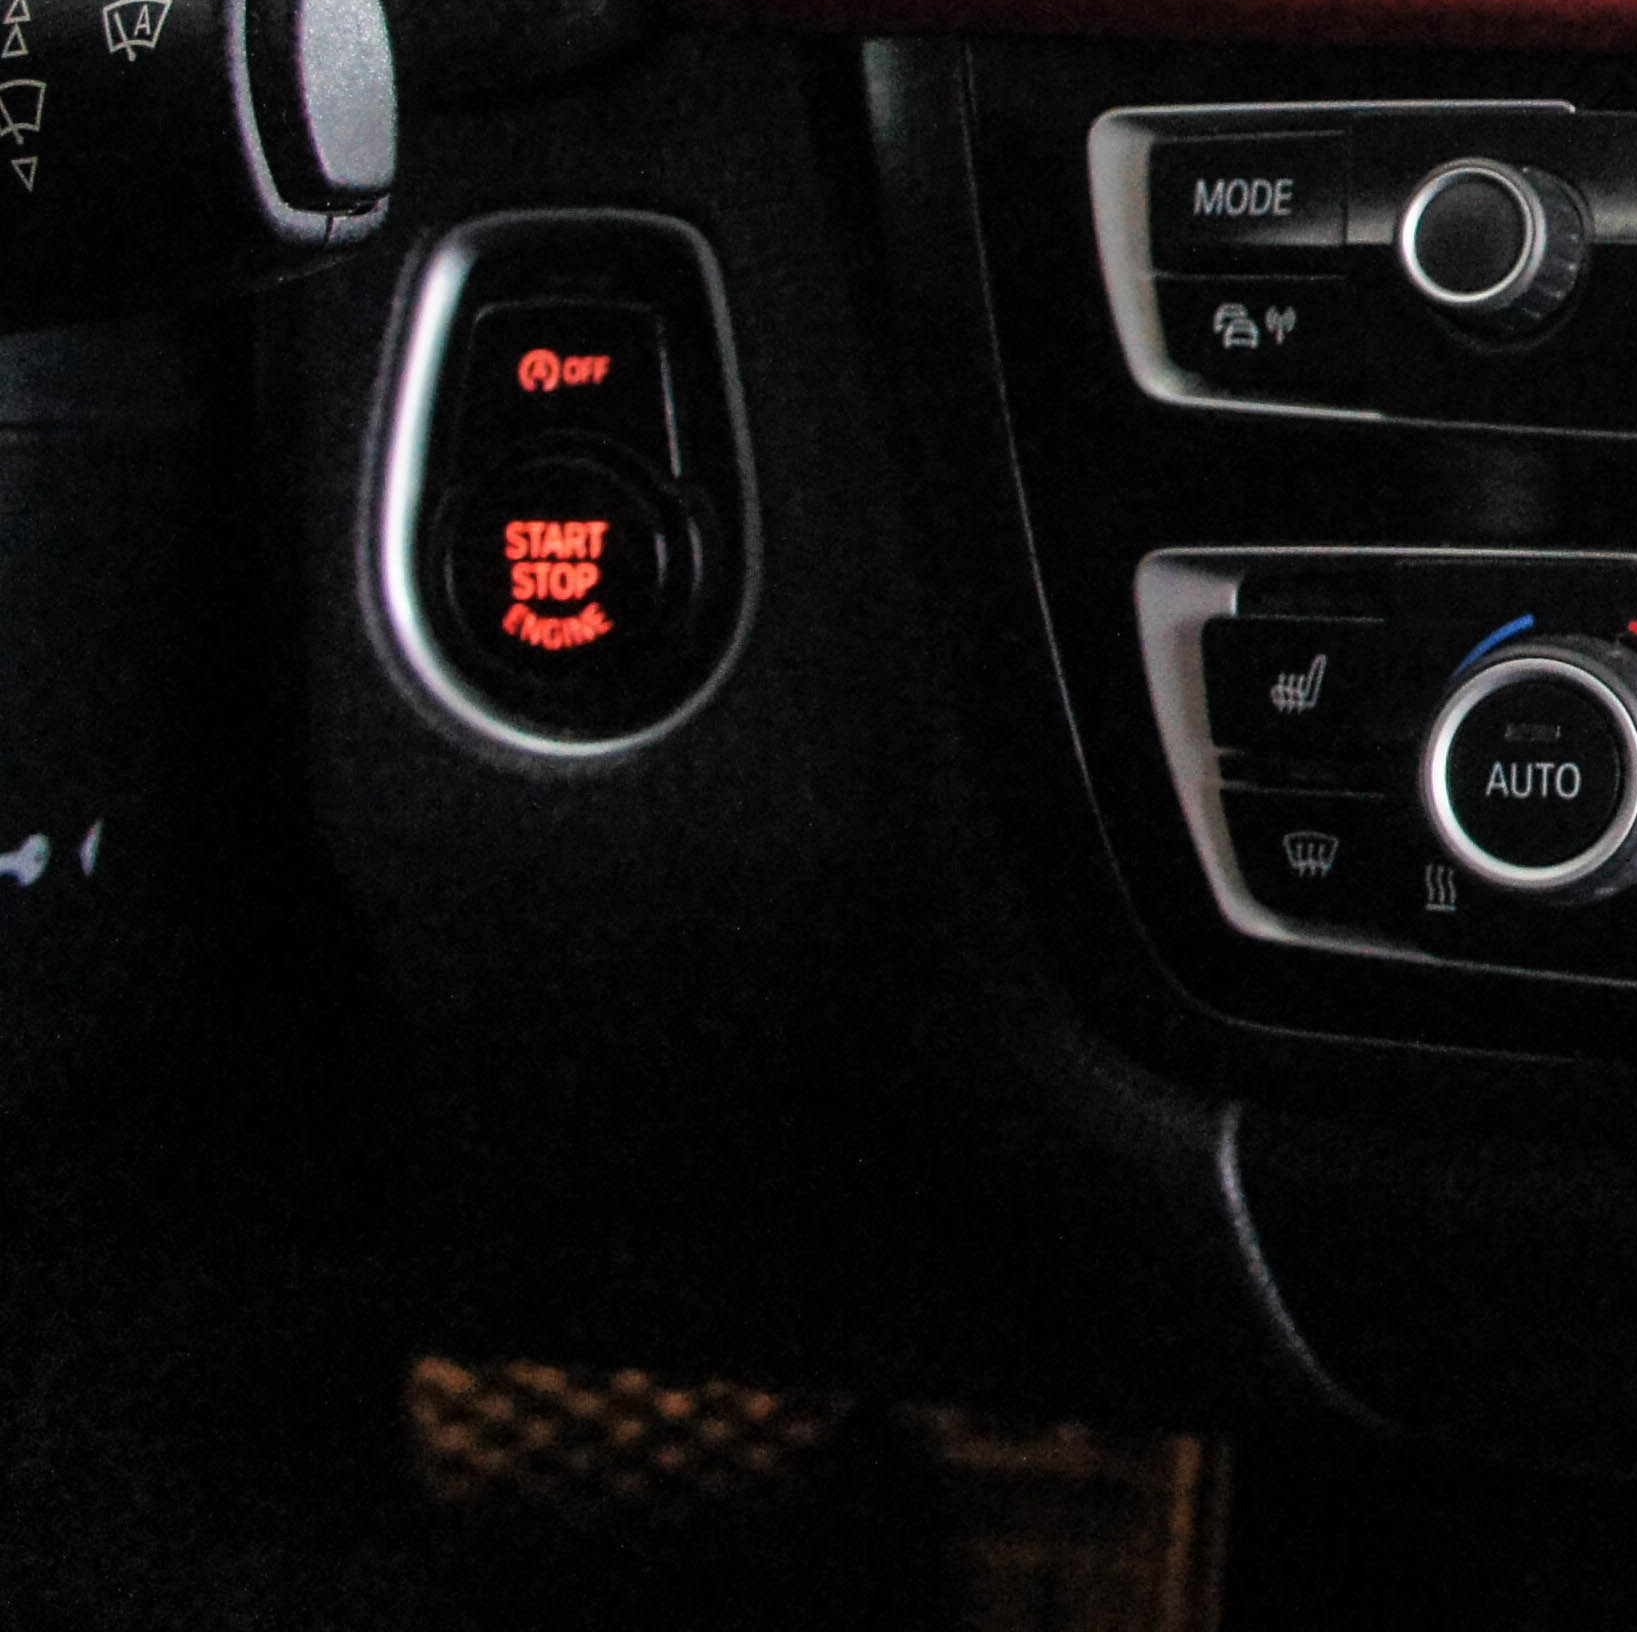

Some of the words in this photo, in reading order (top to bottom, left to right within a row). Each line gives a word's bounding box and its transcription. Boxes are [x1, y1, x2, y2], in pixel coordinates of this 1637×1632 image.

[1193, 178, 1294, 217] MODE
[561, 355, 610, 385] OFF
[505, 520, 609, 560] START
[511, 561, 600, 600] STOP
[502, 601, 613, 651] ENGINE
[1485, 761, 1582, 800] AUTO
